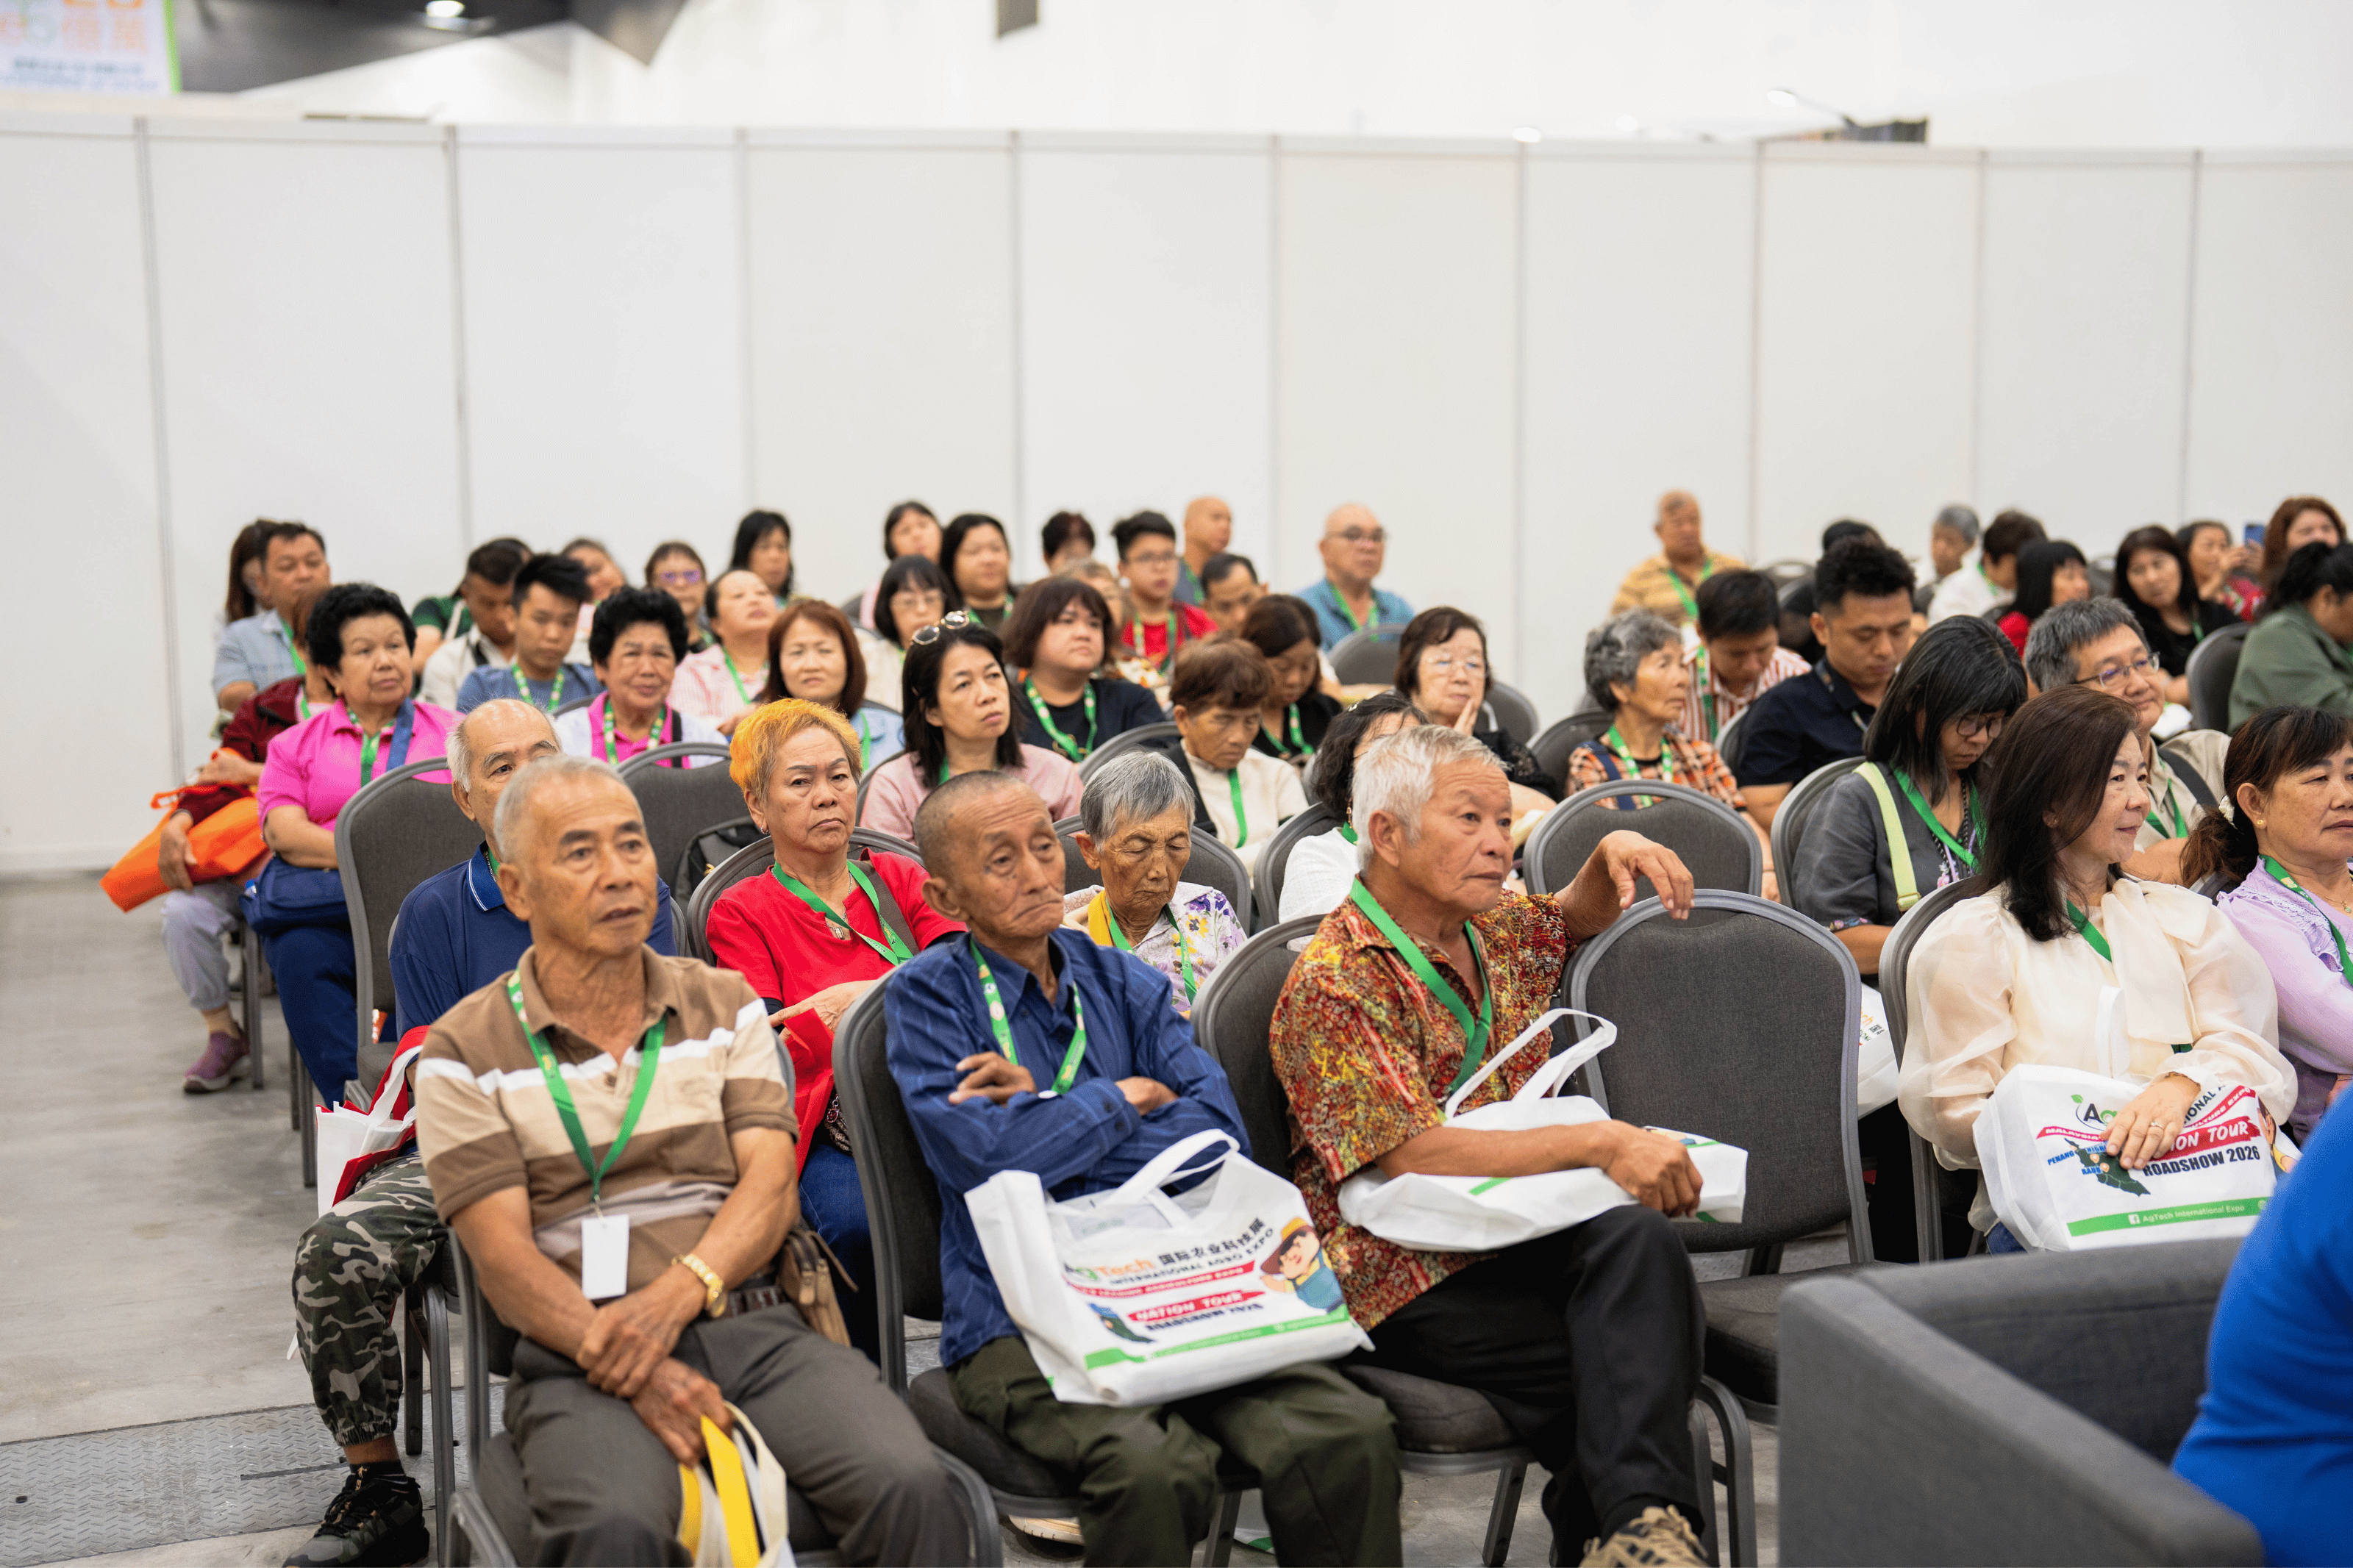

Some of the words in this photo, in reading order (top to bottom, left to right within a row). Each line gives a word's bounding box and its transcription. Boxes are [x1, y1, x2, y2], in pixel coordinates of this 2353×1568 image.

[2184, 1091, 2216, 1125] IONAL
[2228, 1086, 2251, 1106] EXPO
[2046, 1128, 2100, 1141] MALAYSIA'
[2170, 1131, 2199, 1152] ION
[2207, 1121, 2249, 1142] TOUR
[2047, 1150, 2075, 1165] PENANG
[2082, 1167, 2102, 1175] RAUB
[2143, 1151, 2224, 1176] ROADSHOW
[2227, 1146, 2260, 1162] 2026
[2143, 1213, 2174, 1222] AgTech
[2174, 1206, 2224, 1217] International
[1158, 1217, 1265, 1265] 国际农业科技展
[1246, 1228, 1273, 1255] EXPO
[1136, 1301, 1195, 1321] NATION
[1202, 1292, 1243, 1308] TOUR
